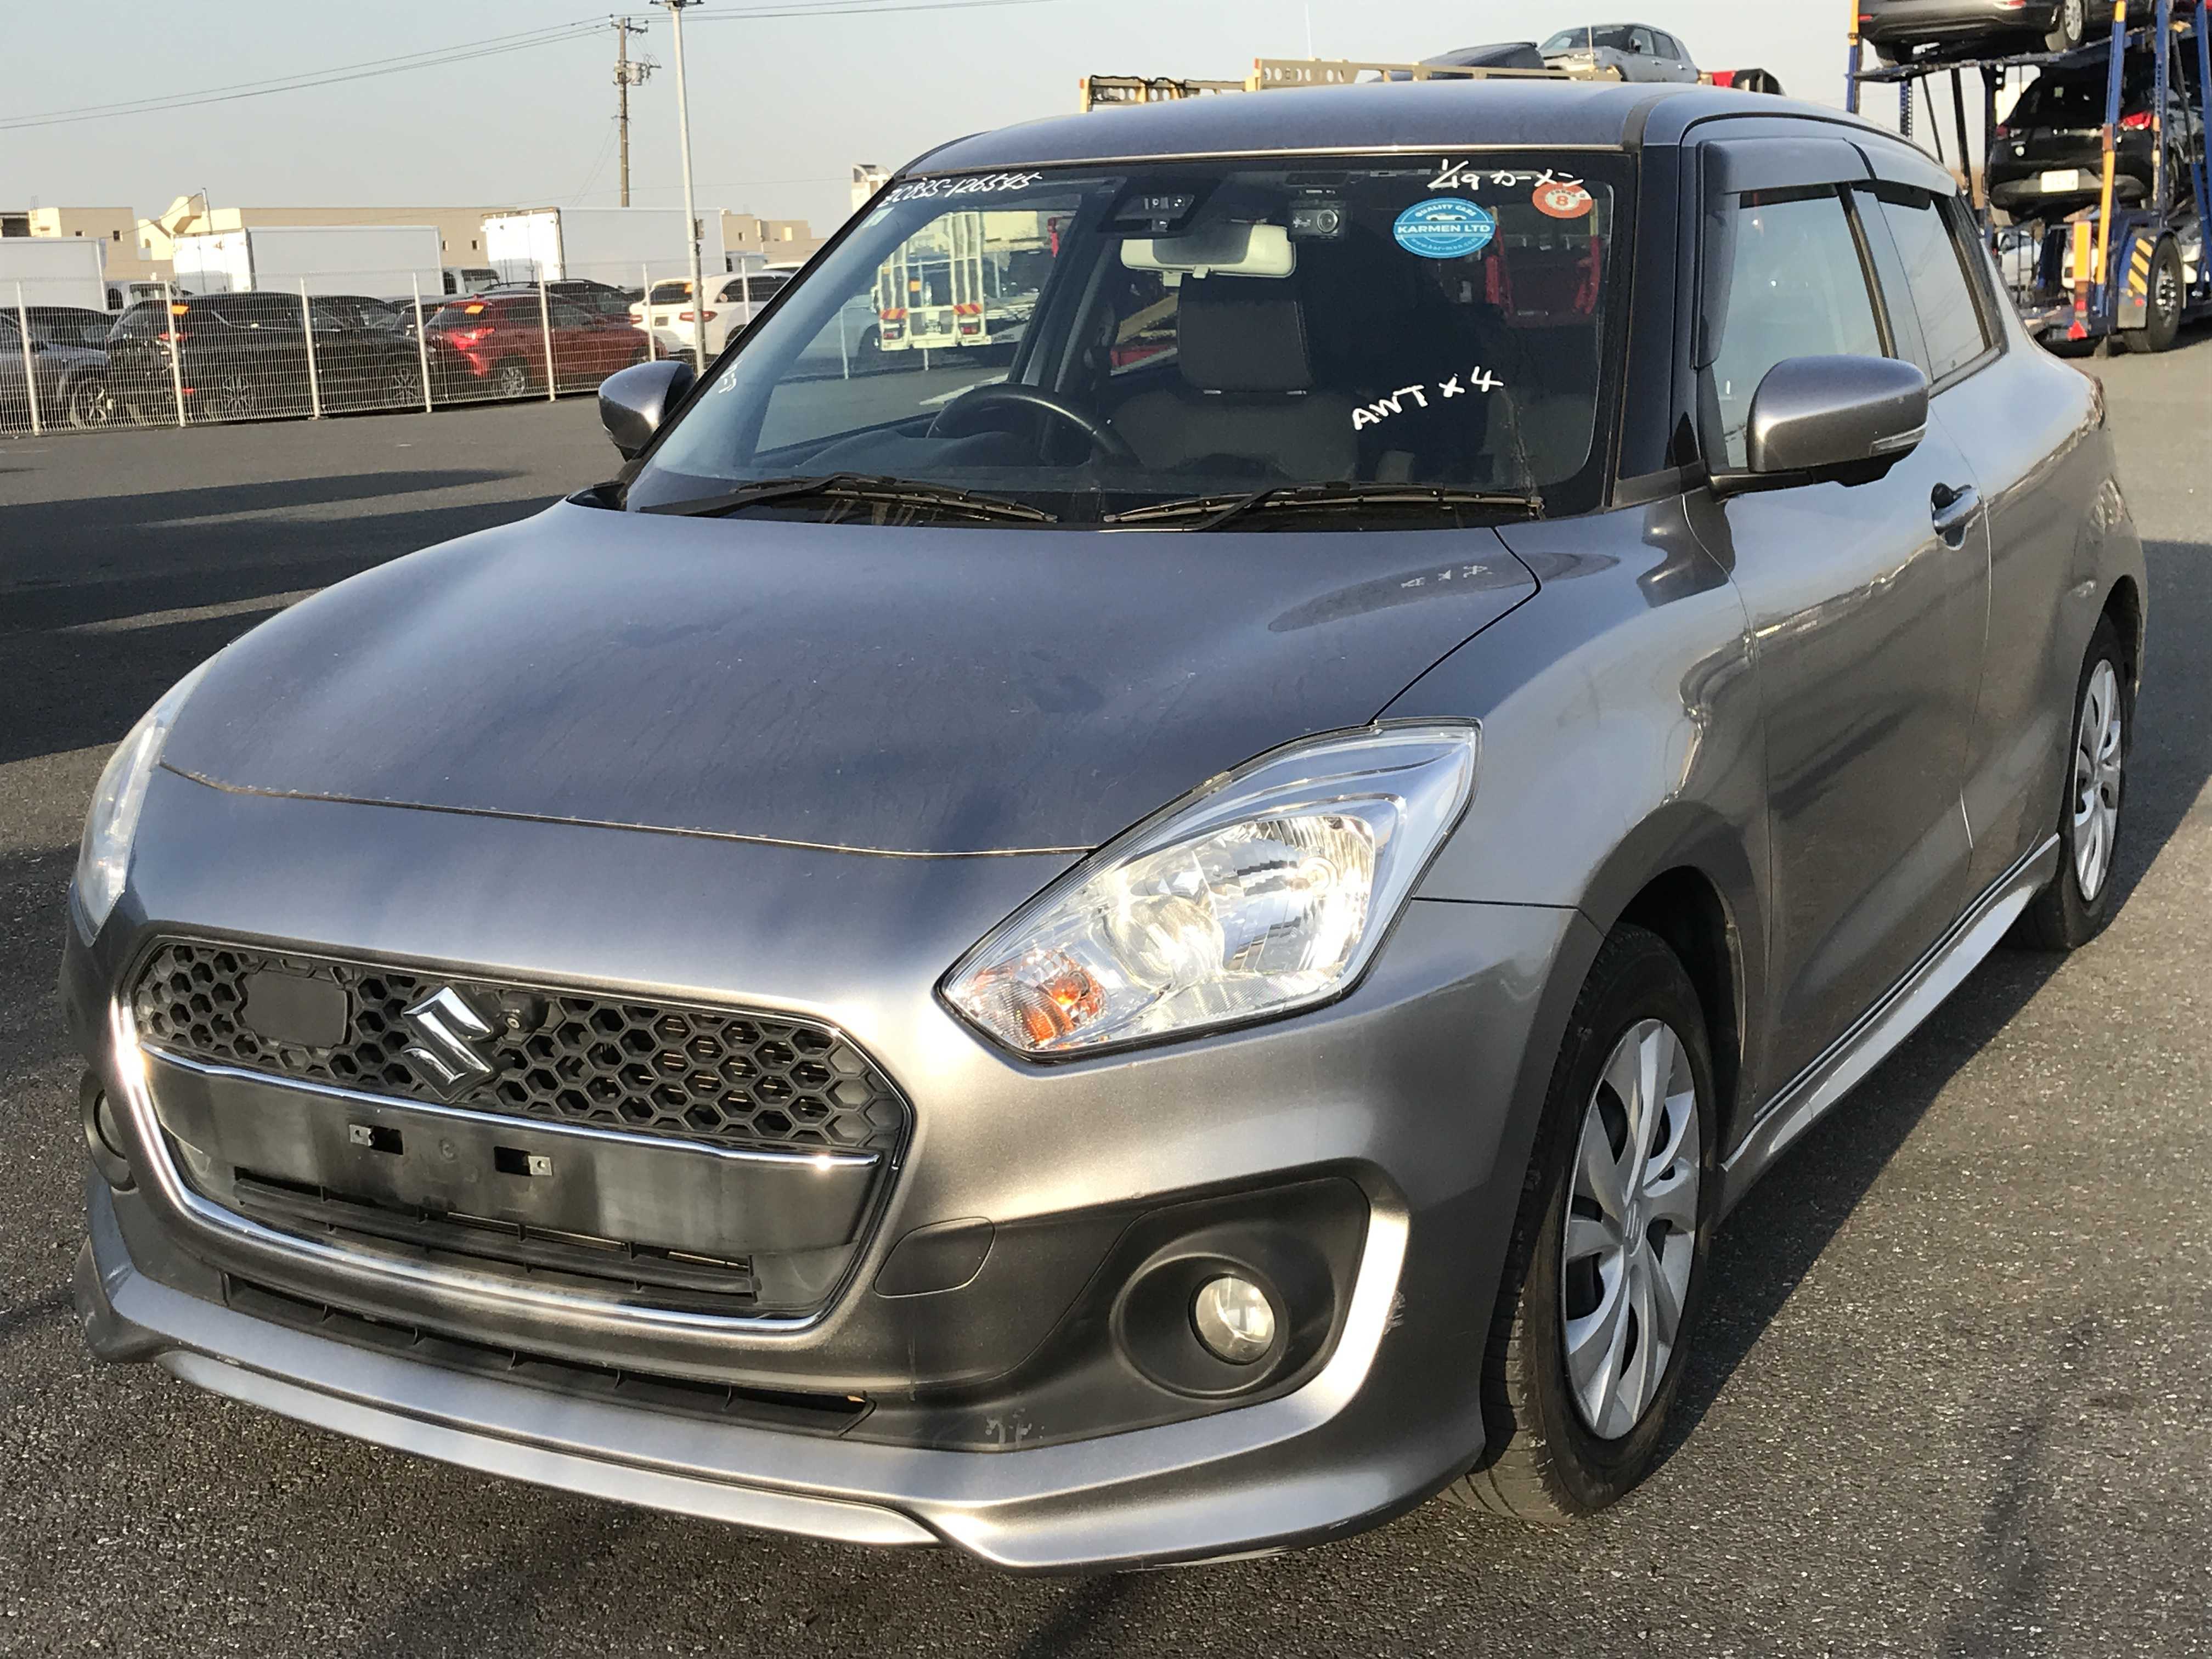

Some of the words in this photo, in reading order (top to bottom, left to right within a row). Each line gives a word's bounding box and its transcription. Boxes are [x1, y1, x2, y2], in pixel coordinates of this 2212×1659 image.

[1556, 195, 1568, 206] 8
[1415, 204, 1453, 217] QUALITY
[1455, 205, 1477, 216] CARS
[1397, 224, 1461, 233] KARMEN
[1464, 224, 1491, 233] LTD
[1352, 385, 1428, 430] AWT
[1471, 366, 1504, 392] 4
